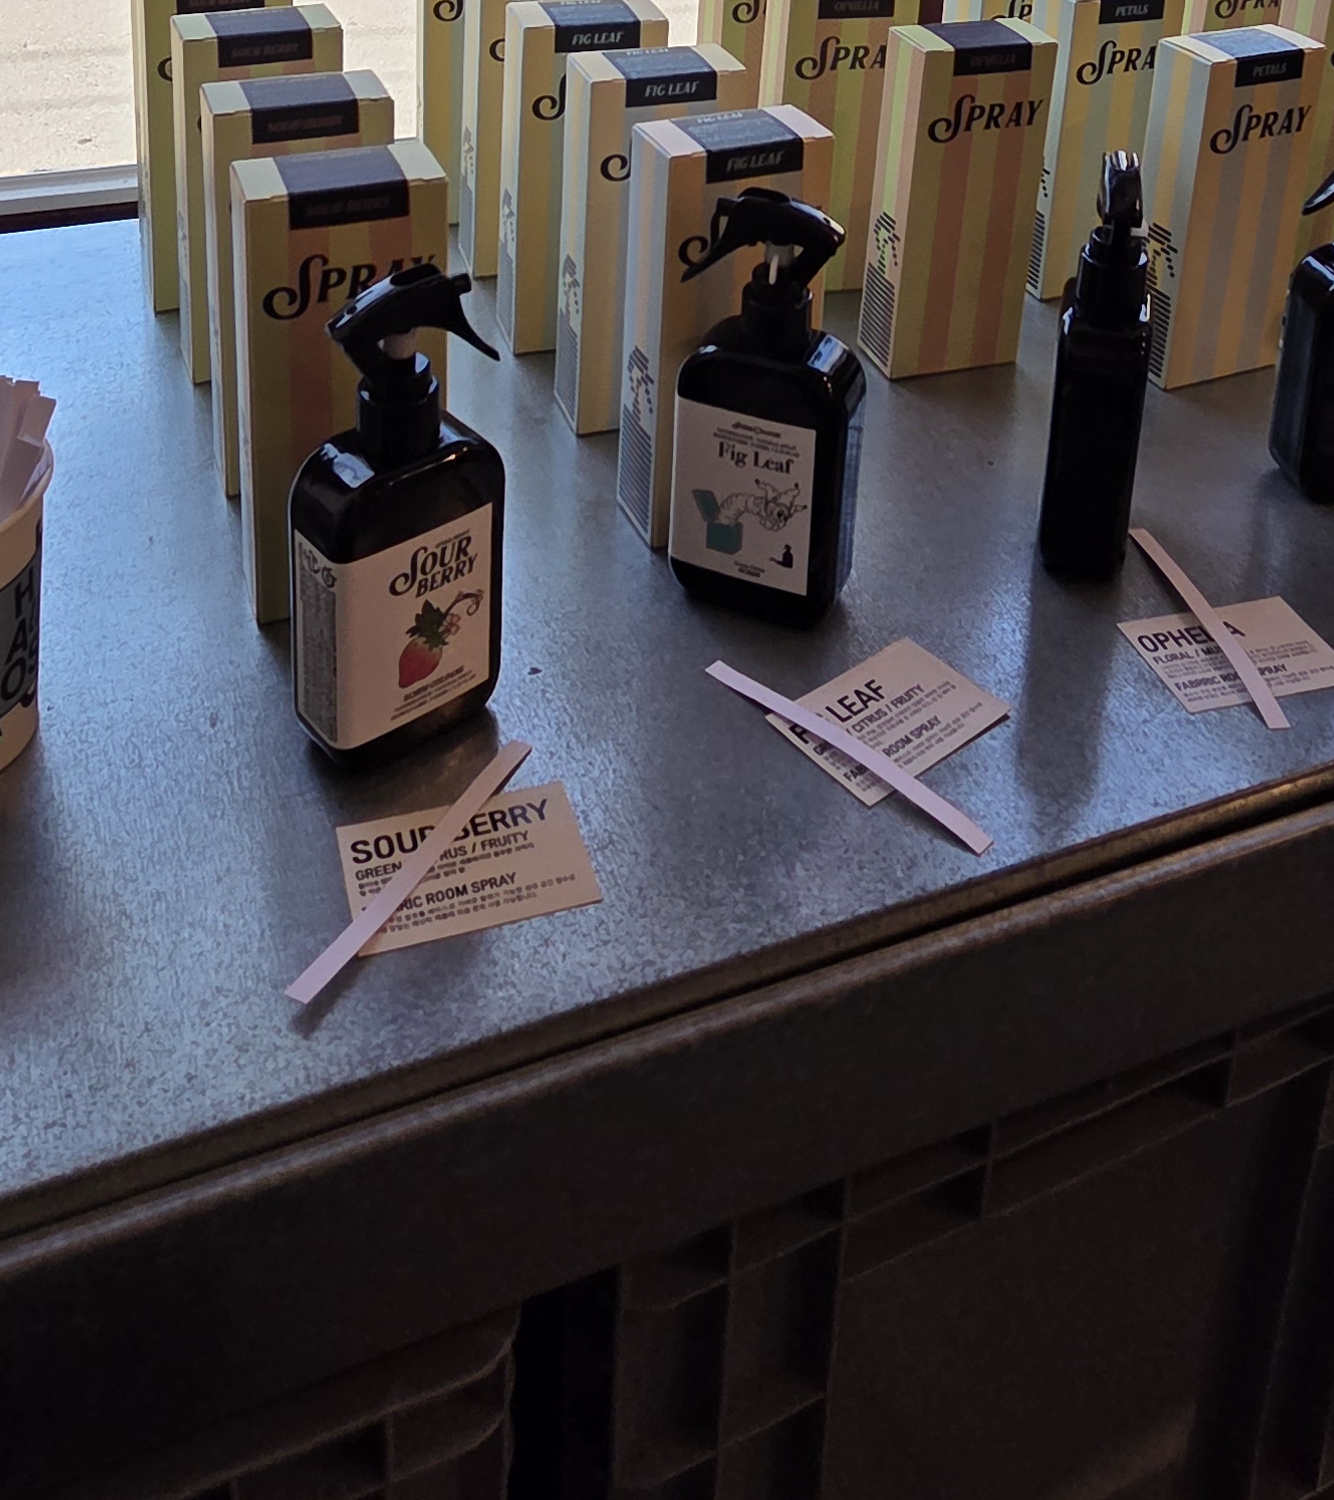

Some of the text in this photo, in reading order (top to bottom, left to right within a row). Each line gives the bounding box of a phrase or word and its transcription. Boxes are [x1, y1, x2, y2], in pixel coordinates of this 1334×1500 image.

[1115, 4, 1149, 17] PETALS
[571, 31, 624, 46] FIG LEAF
[794, 35, 887, 80] SPRA
[1076, 39, 1158, 85] SPRA
[644, 81, 700, 98] FIG LEAF
[927, 94, 1044, 144] SPRAY
[1209, 104, 1314, 155] SPRAY
[726, 150, 785, 172] FIG LEAF
[718, 441, 795, 475] Fig Leaf
[389, 535, 472, 596] SOUR
[415, 553, 478, 598] BERRY
[1152, 649, 1193, 665] FLORAL
[825, 679, 886, 724] LEAF
[852, 708, 889, 734] CITRUS
[893, 683, 926, 710] FRUITY
[881, 735, 913, 758] ROOM
[909, 715, 943, 742] SPRAY
[480, 830, 530, 851] FRUITY
[425, 884, 469, 906] ROOM
[470, 871, 517, 894] SPRAY
